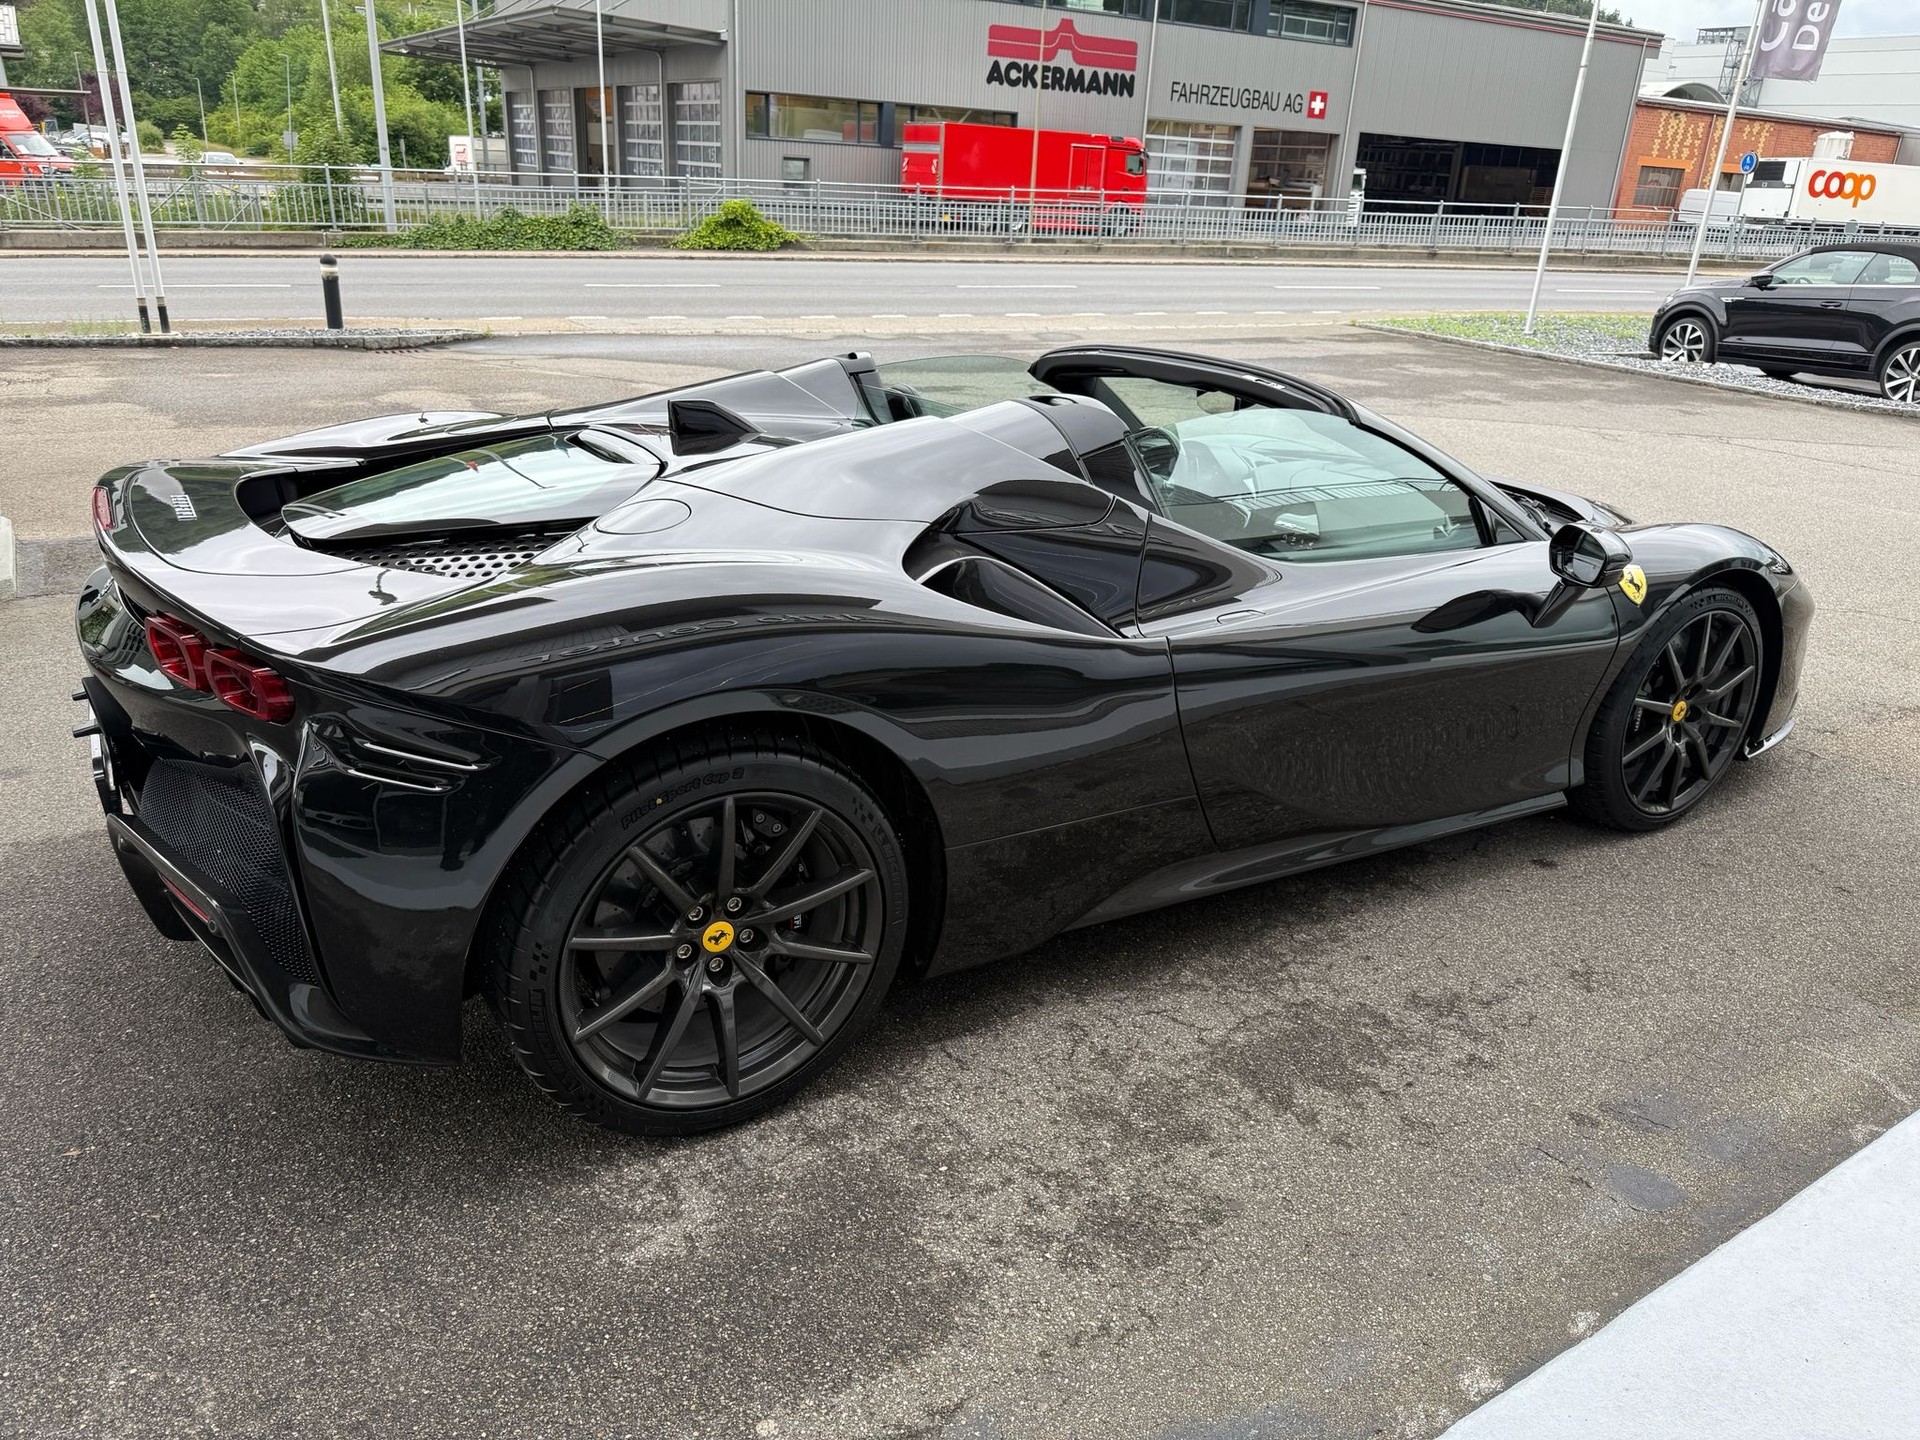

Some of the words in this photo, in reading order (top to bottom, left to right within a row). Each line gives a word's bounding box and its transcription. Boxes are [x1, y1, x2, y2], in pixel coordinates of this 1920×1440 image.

[1792, 1, 1830, 51] De
[986, 59, 1135, 98] ACKERMANN
[1170, 81, 1281, 111] FAHRZEUGBAU
[1283, 92, 1304, 114] AG
[1808, 169, 1876, 208] coop
[703, 771, 731, 786] Cup
[732, 766, 745, 780] 2
